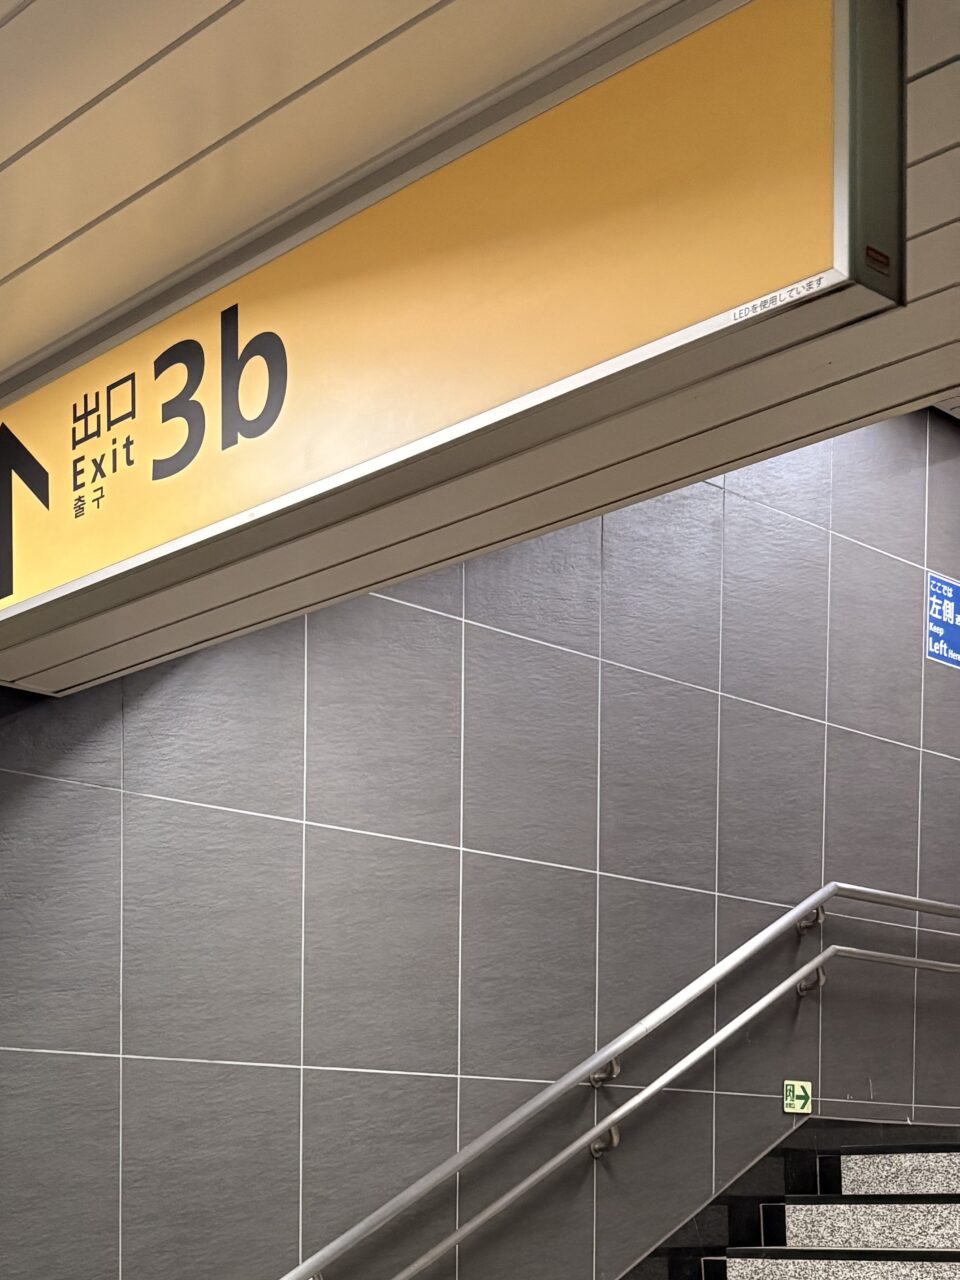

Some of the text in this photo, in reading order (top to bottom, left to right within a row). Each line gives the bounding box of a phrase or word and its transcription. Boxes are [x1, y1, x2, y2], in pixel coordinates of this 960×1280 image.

[732, 276, 824, 321] LEDを使用しています
[71, 371, 136, 451] 出口
[152, 303, 288, 481] 3b
[72, 434, 135, 492] Exit
[73, 486, 105, 519] 출구
[929, 622, 944, 637] Keep
[929, 637, 960, 662] Left Her
